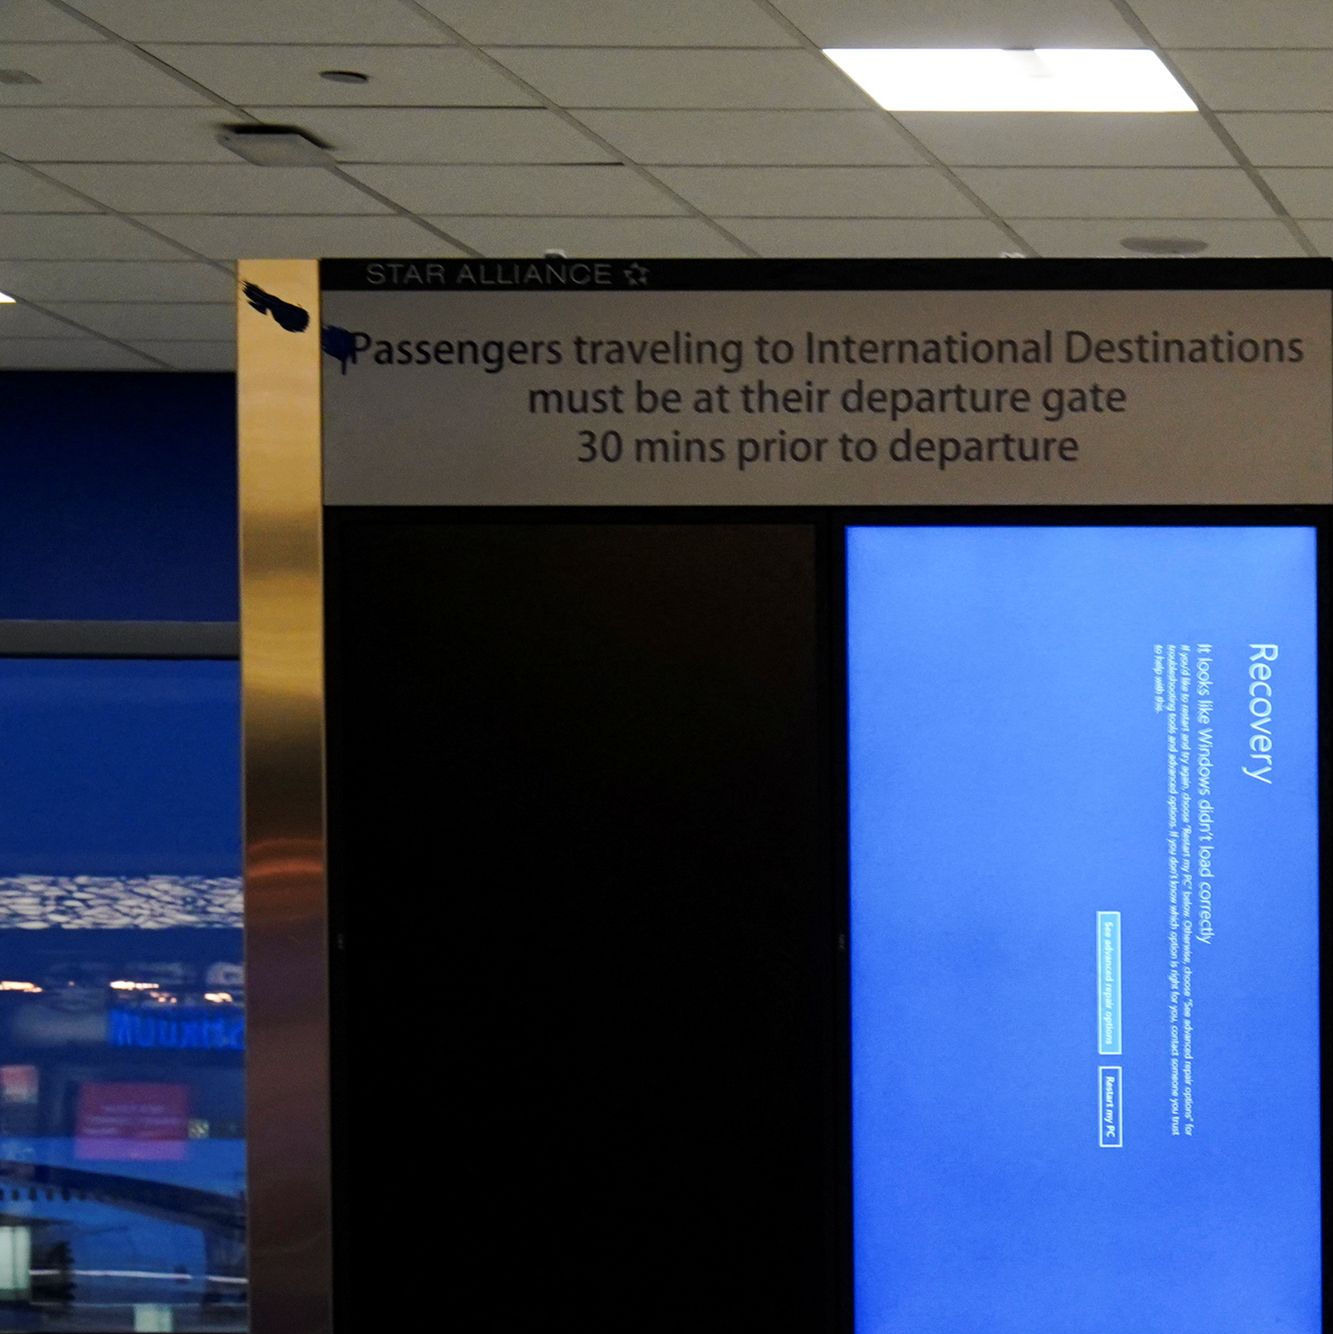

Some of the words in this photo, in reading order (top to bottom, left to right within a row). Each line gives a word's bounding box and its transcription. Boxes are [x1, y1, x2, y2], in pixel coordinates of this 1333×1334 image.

[367, 263, 445, 284] STAR
[457, 263, 611, 285] ALLIANCE
[351, 331, 563, 373] Passengers
[573, 330, 743, 373] traveling
[755, 336, 794, 364] to
[807, 329, 1051, 364] International
[1066, 330, 1303, 363] Destinations
[528, 385, 624, 415] must
[635, 379, 682, 414] be
[693, 385, 730, 414] at
[740, 379, 830, 413] their
[841, 377, 1030, 421] departure
[1042, 384, 1126, 420] gate
[577, 429, 623, 463] 30
[635, 429, 726, 464] mins
[738, 430, 828, 472] prior
[839, 434, 877, 462] to
[889, 427, 1078, 470] departure
[1197, 644, 1212, 653] It
[1197, 658, 1213, 696] looks
[1198, 700, 1213, 724] like
[1242, 644, 1278, 784] Recovery
[1197, 728, 1213, 795] Windows
[1199, 846, 1214, 877] load
[1104, 922, 1114, 938] See
[1196, 882, 1215, 944] correctly
[1104, 939, 1114, 982] advanced
[1104, 983, 1113, 1009] repair
[1104, 1011, 1113, 1044] options
[1106, 1076, 1115, 1108] Restart
